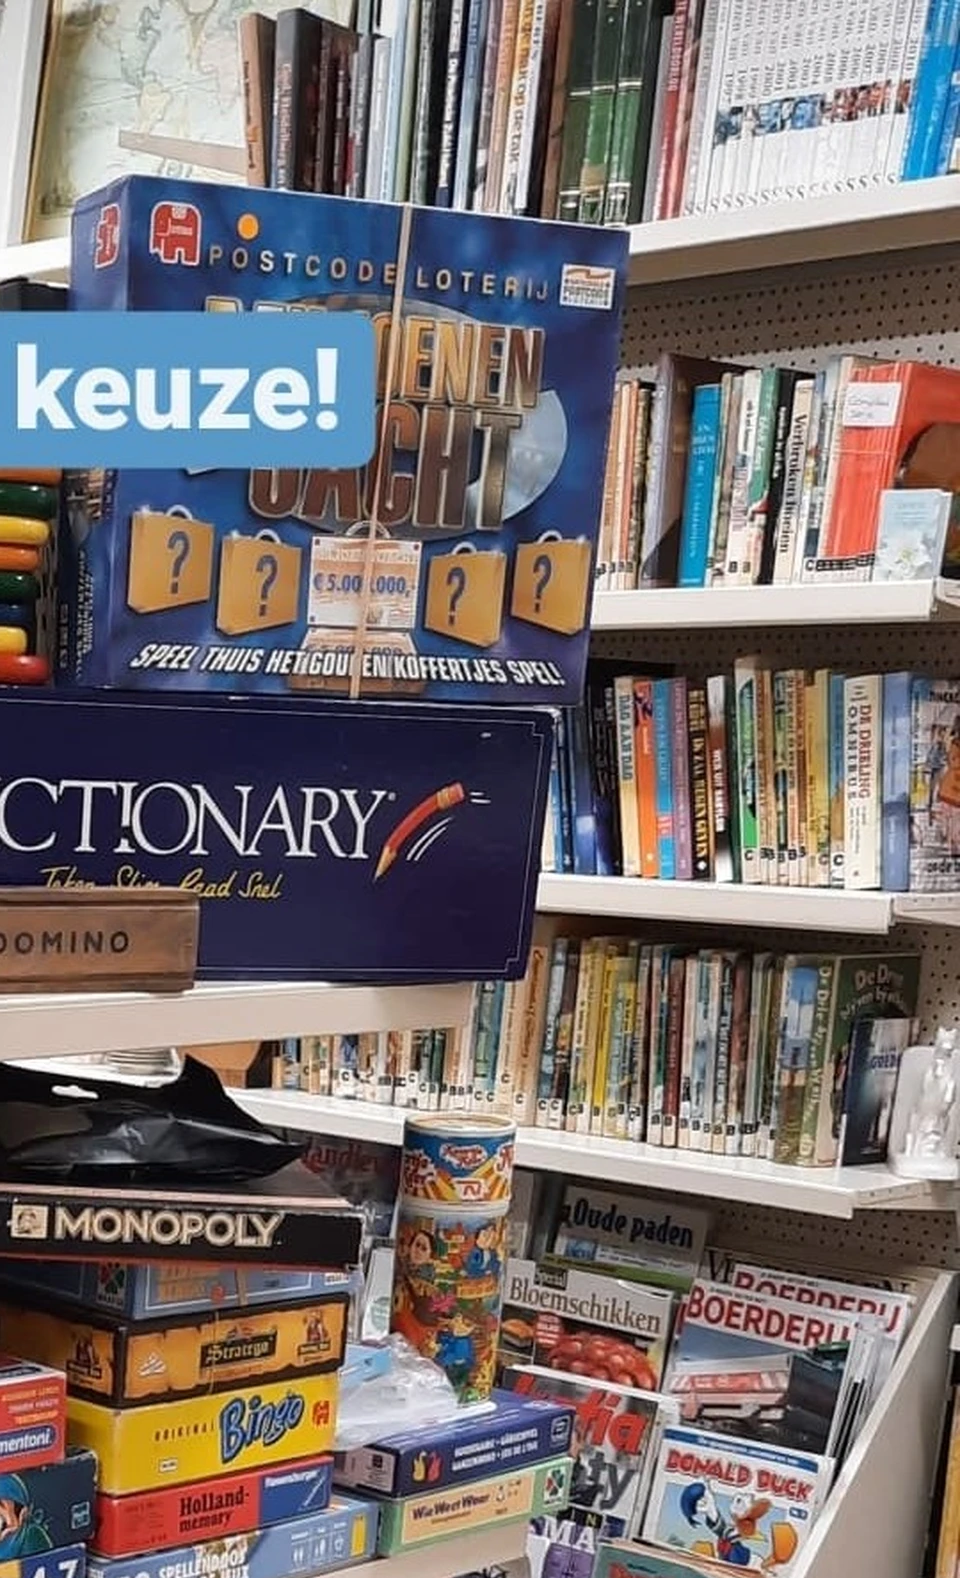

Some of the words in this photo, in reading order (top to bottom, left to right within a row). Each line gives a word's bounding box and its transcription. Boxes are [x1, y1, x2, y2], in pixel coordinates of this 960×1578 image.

[207, 244, 398, 285] POSTCODE
[416, 268, 549, 301] LOTERIJ
[131, 643, 202, 669] SPEEL
[201, 647, 261, 671] THUIS
[267, 649, 303, 674] HET
[307, 650, 390, 679] GOUEN
[390, 653, 507, 683] KOFFERTJES
[508, 656, 567, 688] SPEL!
[859, 703, 872, 724] DE
[847, 705, 859, 801] OMNIBUS
[858, 728, 872, 799] DRIELING
[53, 1205, 283, 1249] MONOPOLY
[573, 1197, 628, 1239] Oude
[630, 1208, 694, 1250] paden
[509, 1275, 662, 1336] Bloemschikken
[154, 1423, 216, 1442] ORIGINAL
[219, 1391, 306, 1465] Bingo
[179, 1485, 250, 1517] Holland-
[664, 1449, 752, 1487] DONALD
[755, 1470, 814, 1501] DUCK
